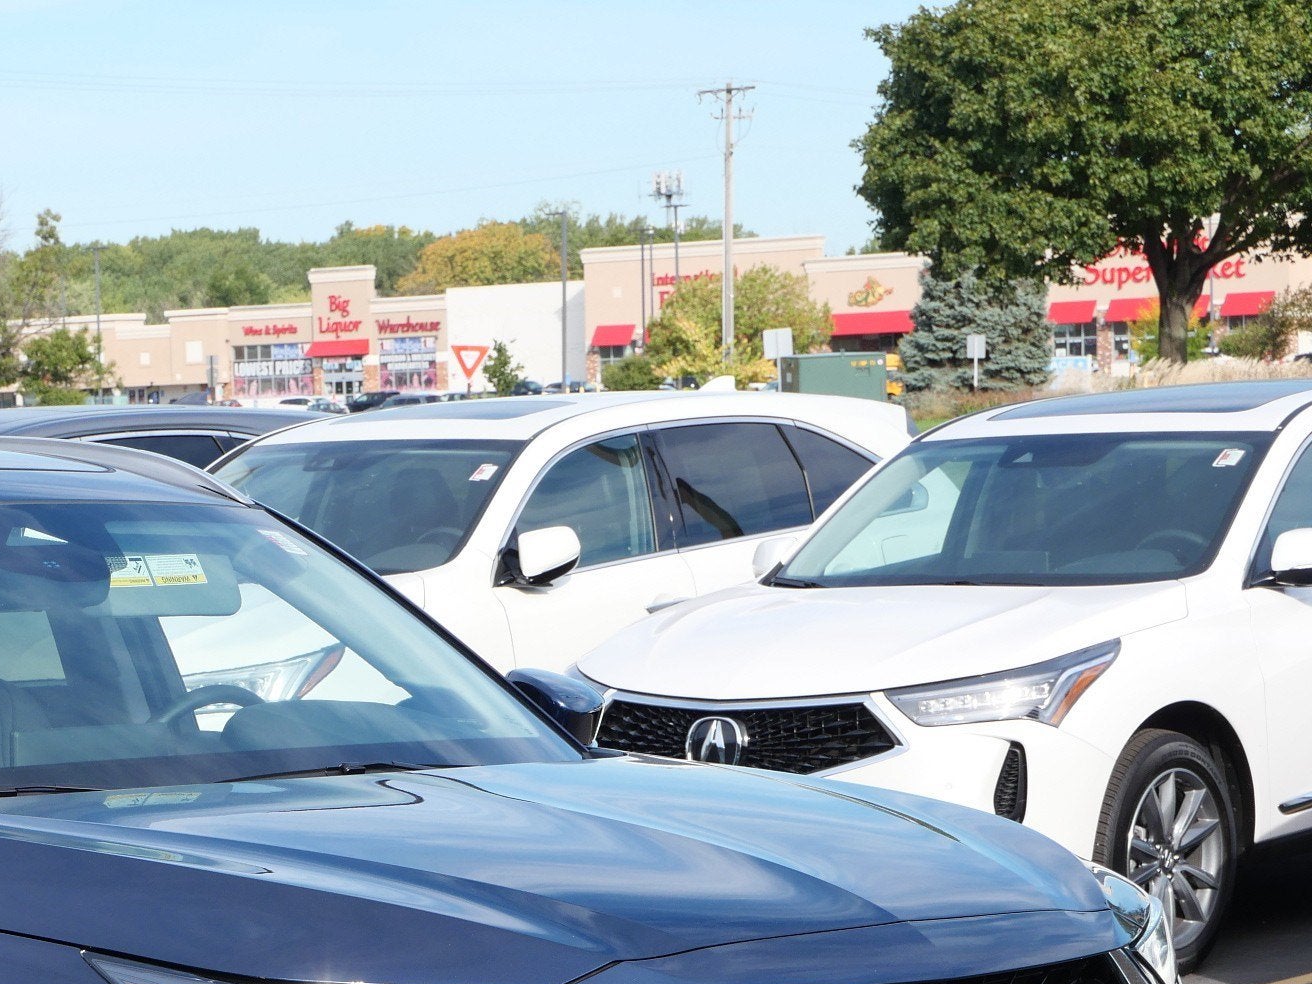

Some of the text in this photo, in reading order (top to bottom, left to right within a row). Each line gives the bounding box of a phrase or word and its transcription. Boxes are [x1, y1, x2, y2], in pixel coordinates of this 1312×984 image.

[329, 295, 350, 318] Big
[273, 324, 297, 338] Spirits
[318, 317, 362, 338] Liquor
[375, 316, 441, 334] Warehouse
[234, 361, 274, 376] LOWEST
[275, 360, 312, 375] PRICES
